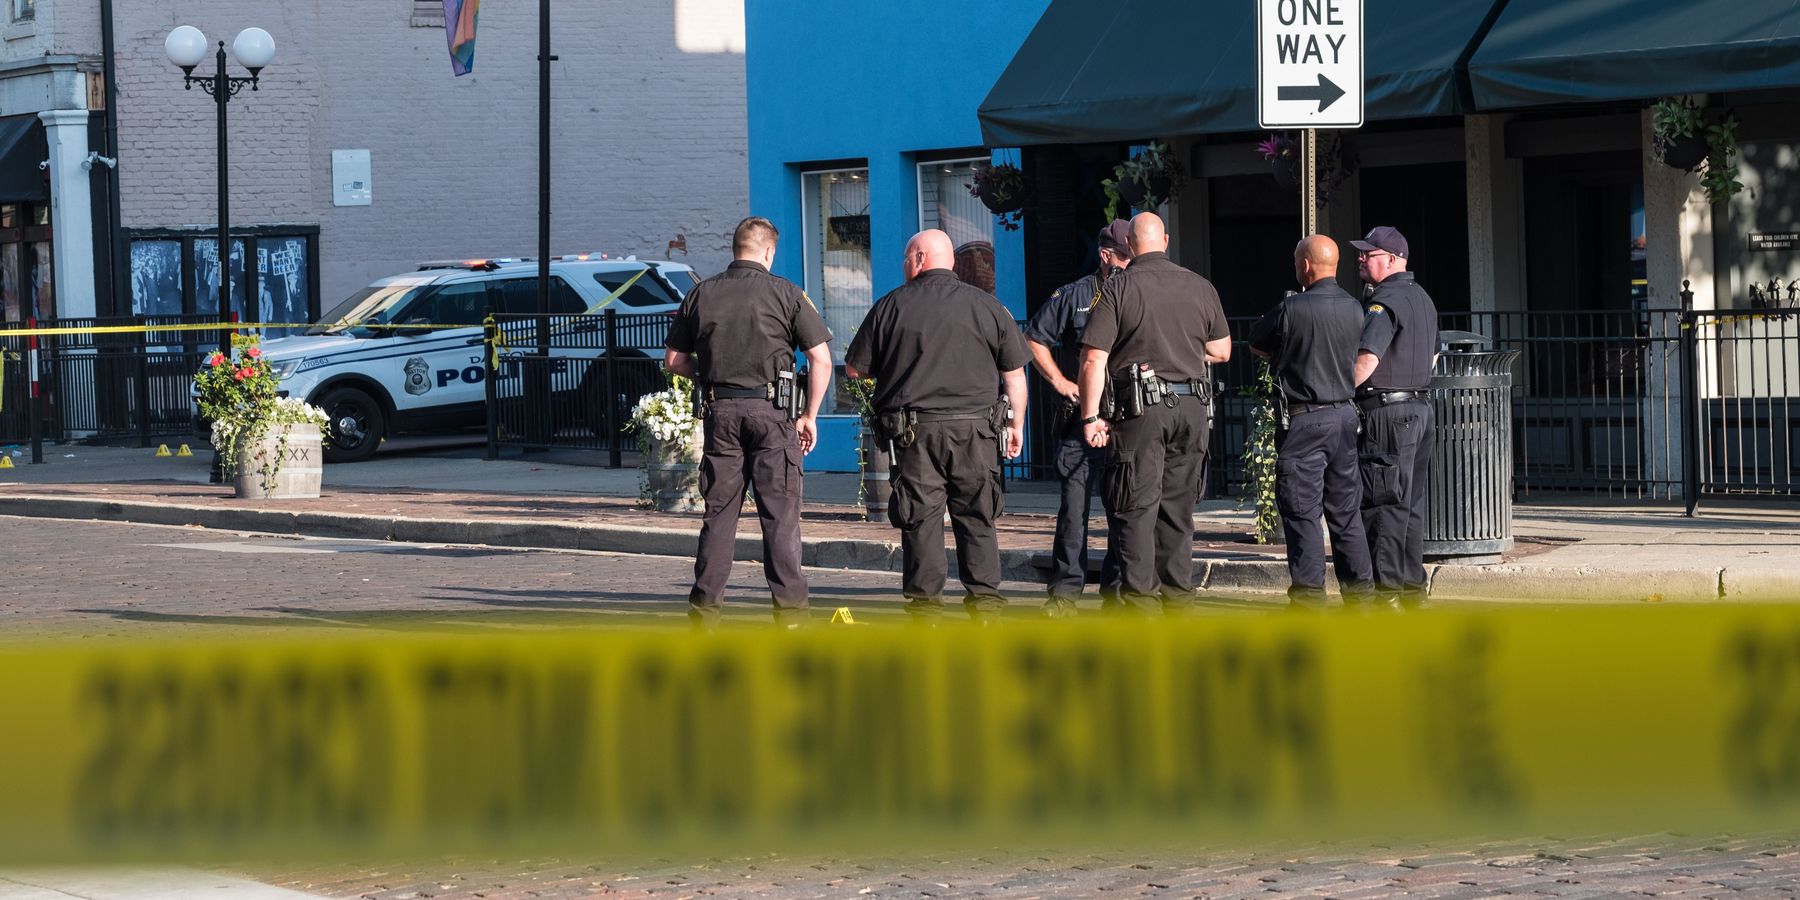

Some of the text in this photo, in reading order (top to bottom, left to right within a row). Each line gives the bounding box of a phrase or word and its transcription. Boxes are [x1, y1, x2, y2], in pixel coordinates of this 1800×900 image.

[1278, 0, 1344, 26] ONE
[1276, 34, 1346, 64] WAY
[274, 251, 291, 259] WE
[273, 256, 294, 267] WANT
[274, 263, 296, 274] BEER
